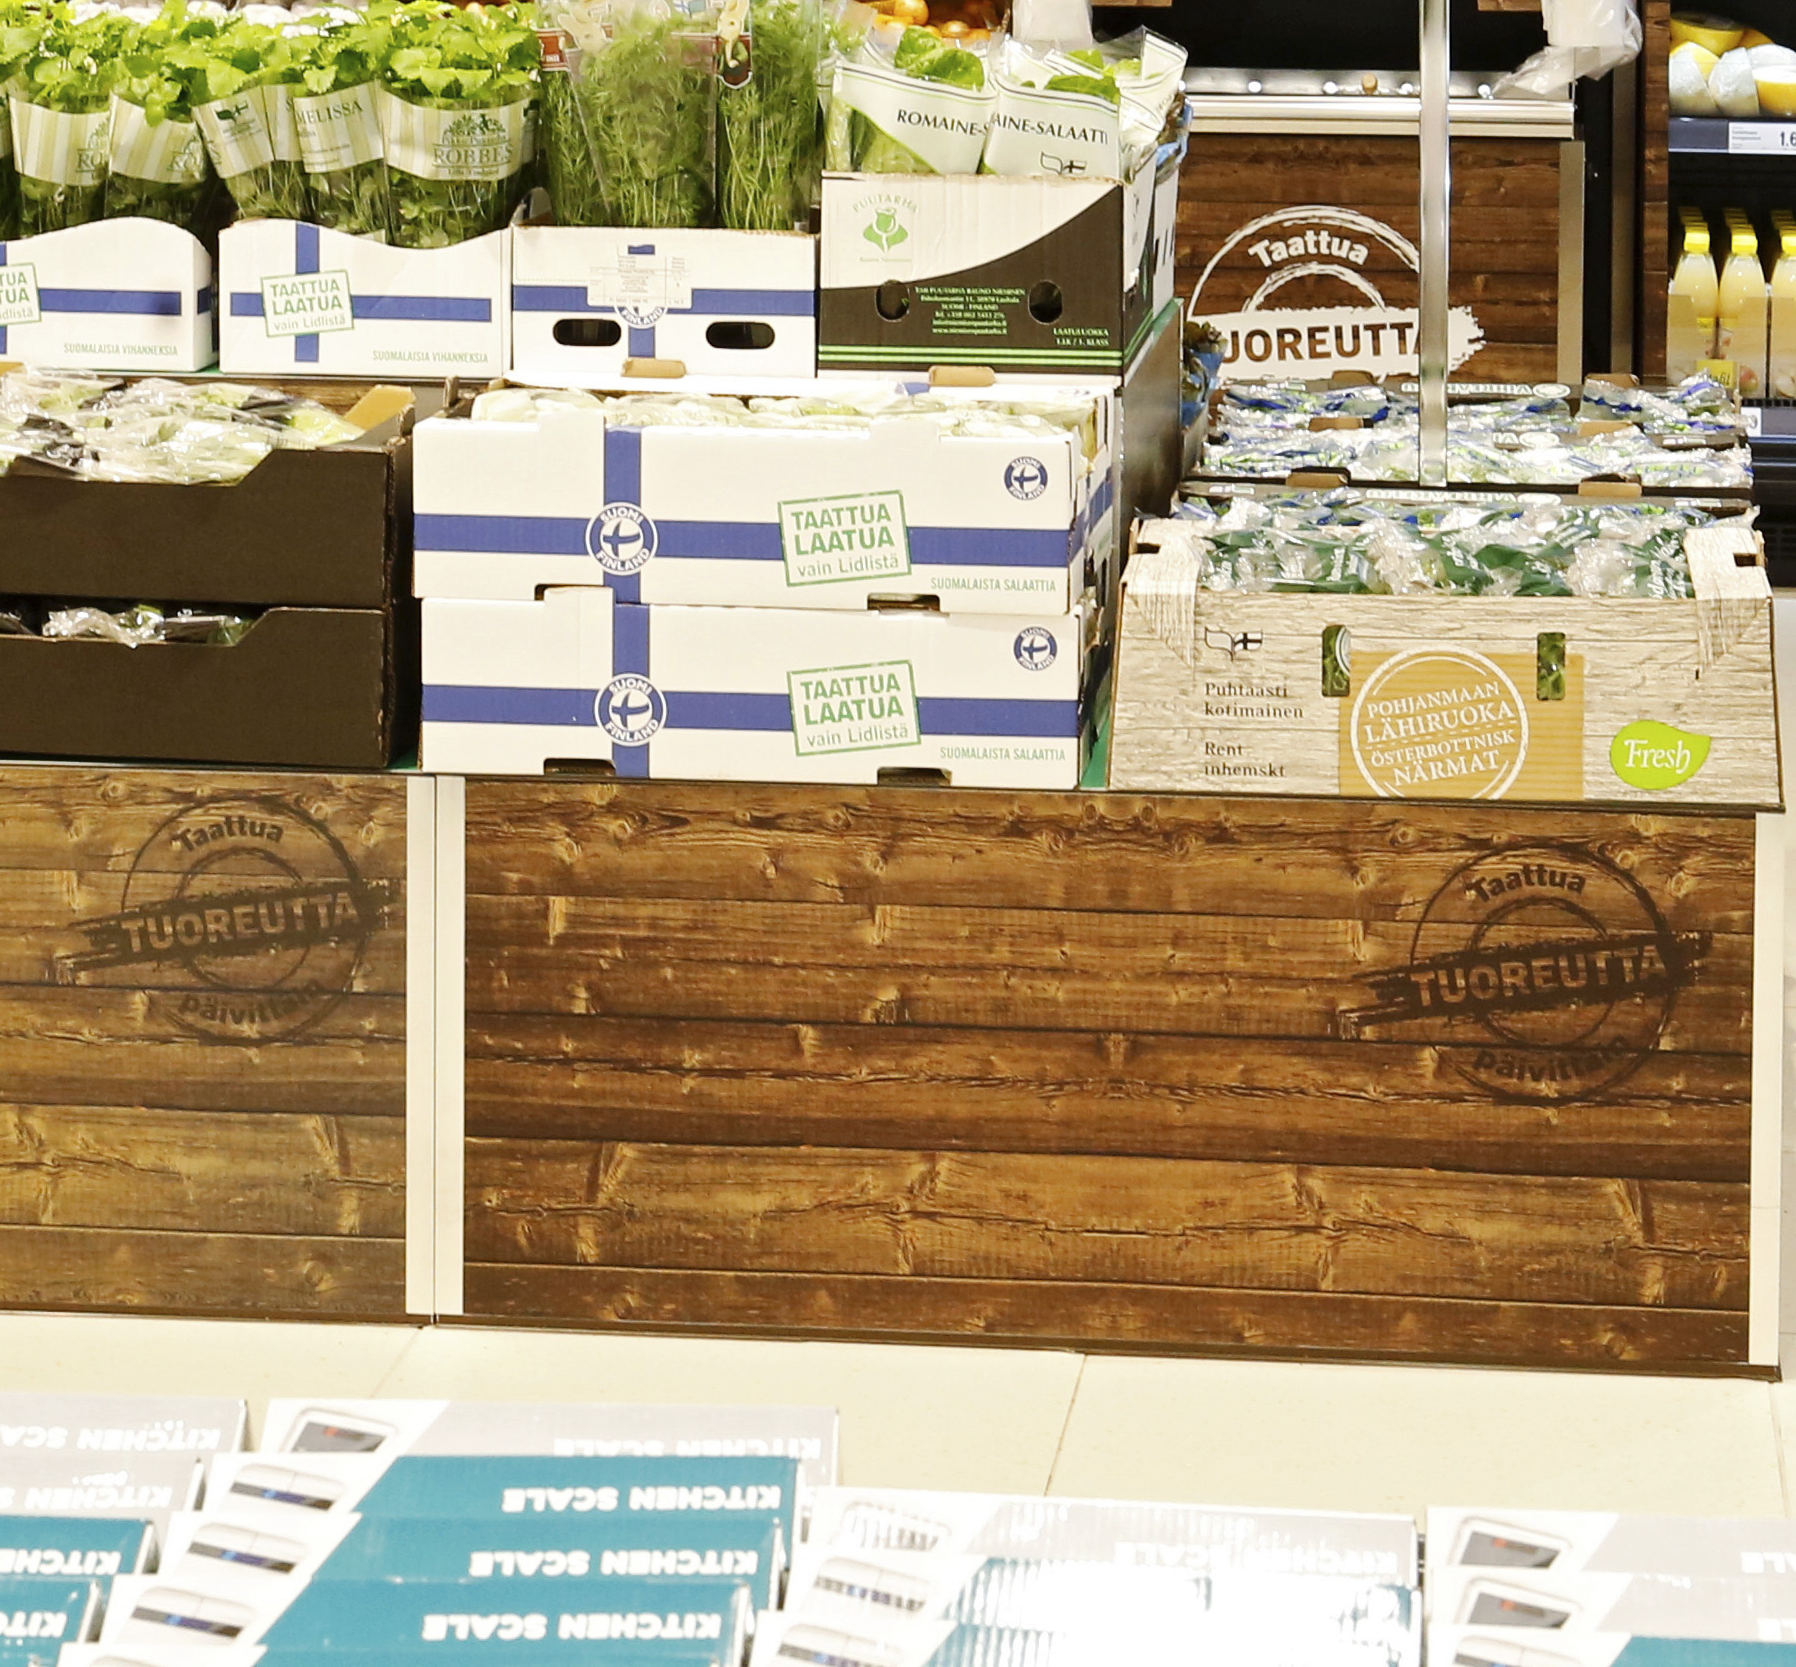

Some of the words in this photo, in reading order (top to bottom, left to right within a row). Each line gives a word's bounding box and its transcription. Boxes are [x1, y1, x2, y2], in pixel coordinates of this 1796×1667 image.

[295, 100, 364, 124] MELISSA
[433, 144, 513, 164] ROBBES
[1248, 230, 1368, 268] Taattua
[270, 278, 340, 297] TAATTUA
[272, 295, 342, 316] LAATUA
[274, 318, 299, 331] vain
[303, 314, 346, 329] Lidlistä
[64, 343, 121, 355] SUOMALAISIA
[122, 344, 178, 356] VIHANNEKSIA
[791, 503, 892, 531] TAATTUA
[794, 526, 895, 556] LAATUA
[797, 560, 832, 577] vain
[839, 555, 899, 573] Lidlistä
[931, 578, 1002, 591] SUOMALAISTA
[1004, 579, 1056, 592] SALAATTIA
[800, 673, 901, 700] TAATTUA
[1205, 682, 1288, 698] Puhtaasti
[1366, 681, 1500, 719] POHJANMAAN
[804, 696, 904, 725] LAATUA
[1205, 702, 1304, 718] kotimainen
[1363, 700, 1515, 744] LÄHIRUOKA
[806, 729, 842, 747] vain
[848, 723, 909, 742] Lidlistä
[1370, 729, 1516, 768] ÖSTERBOTTNISK
[940, 747, 1011, 760] SUOMALAISTA
[1013, 748, 1065, 761] SALAATTIA
[1205, 742, 1244, 756] Rent
[1623, 739, 1691, 774] Fresh
[1205, 764, 1286, 778] inhemskt
[1394, 750, 1500, 786] NÄRMAT
[171, 815, 284, 852] Taattua
[120, 893, 355, 954] TUOREUTTA
[1409, 945, 1665, 1008] TUOREUTTA
[502, 1485, 620, 1512] SCALE
[629, 1484, 781, 1511] KITCHEN
[422, 1613, 547, 1642] SCALE
[557, 1612, 722, 1640] KITCHEN
